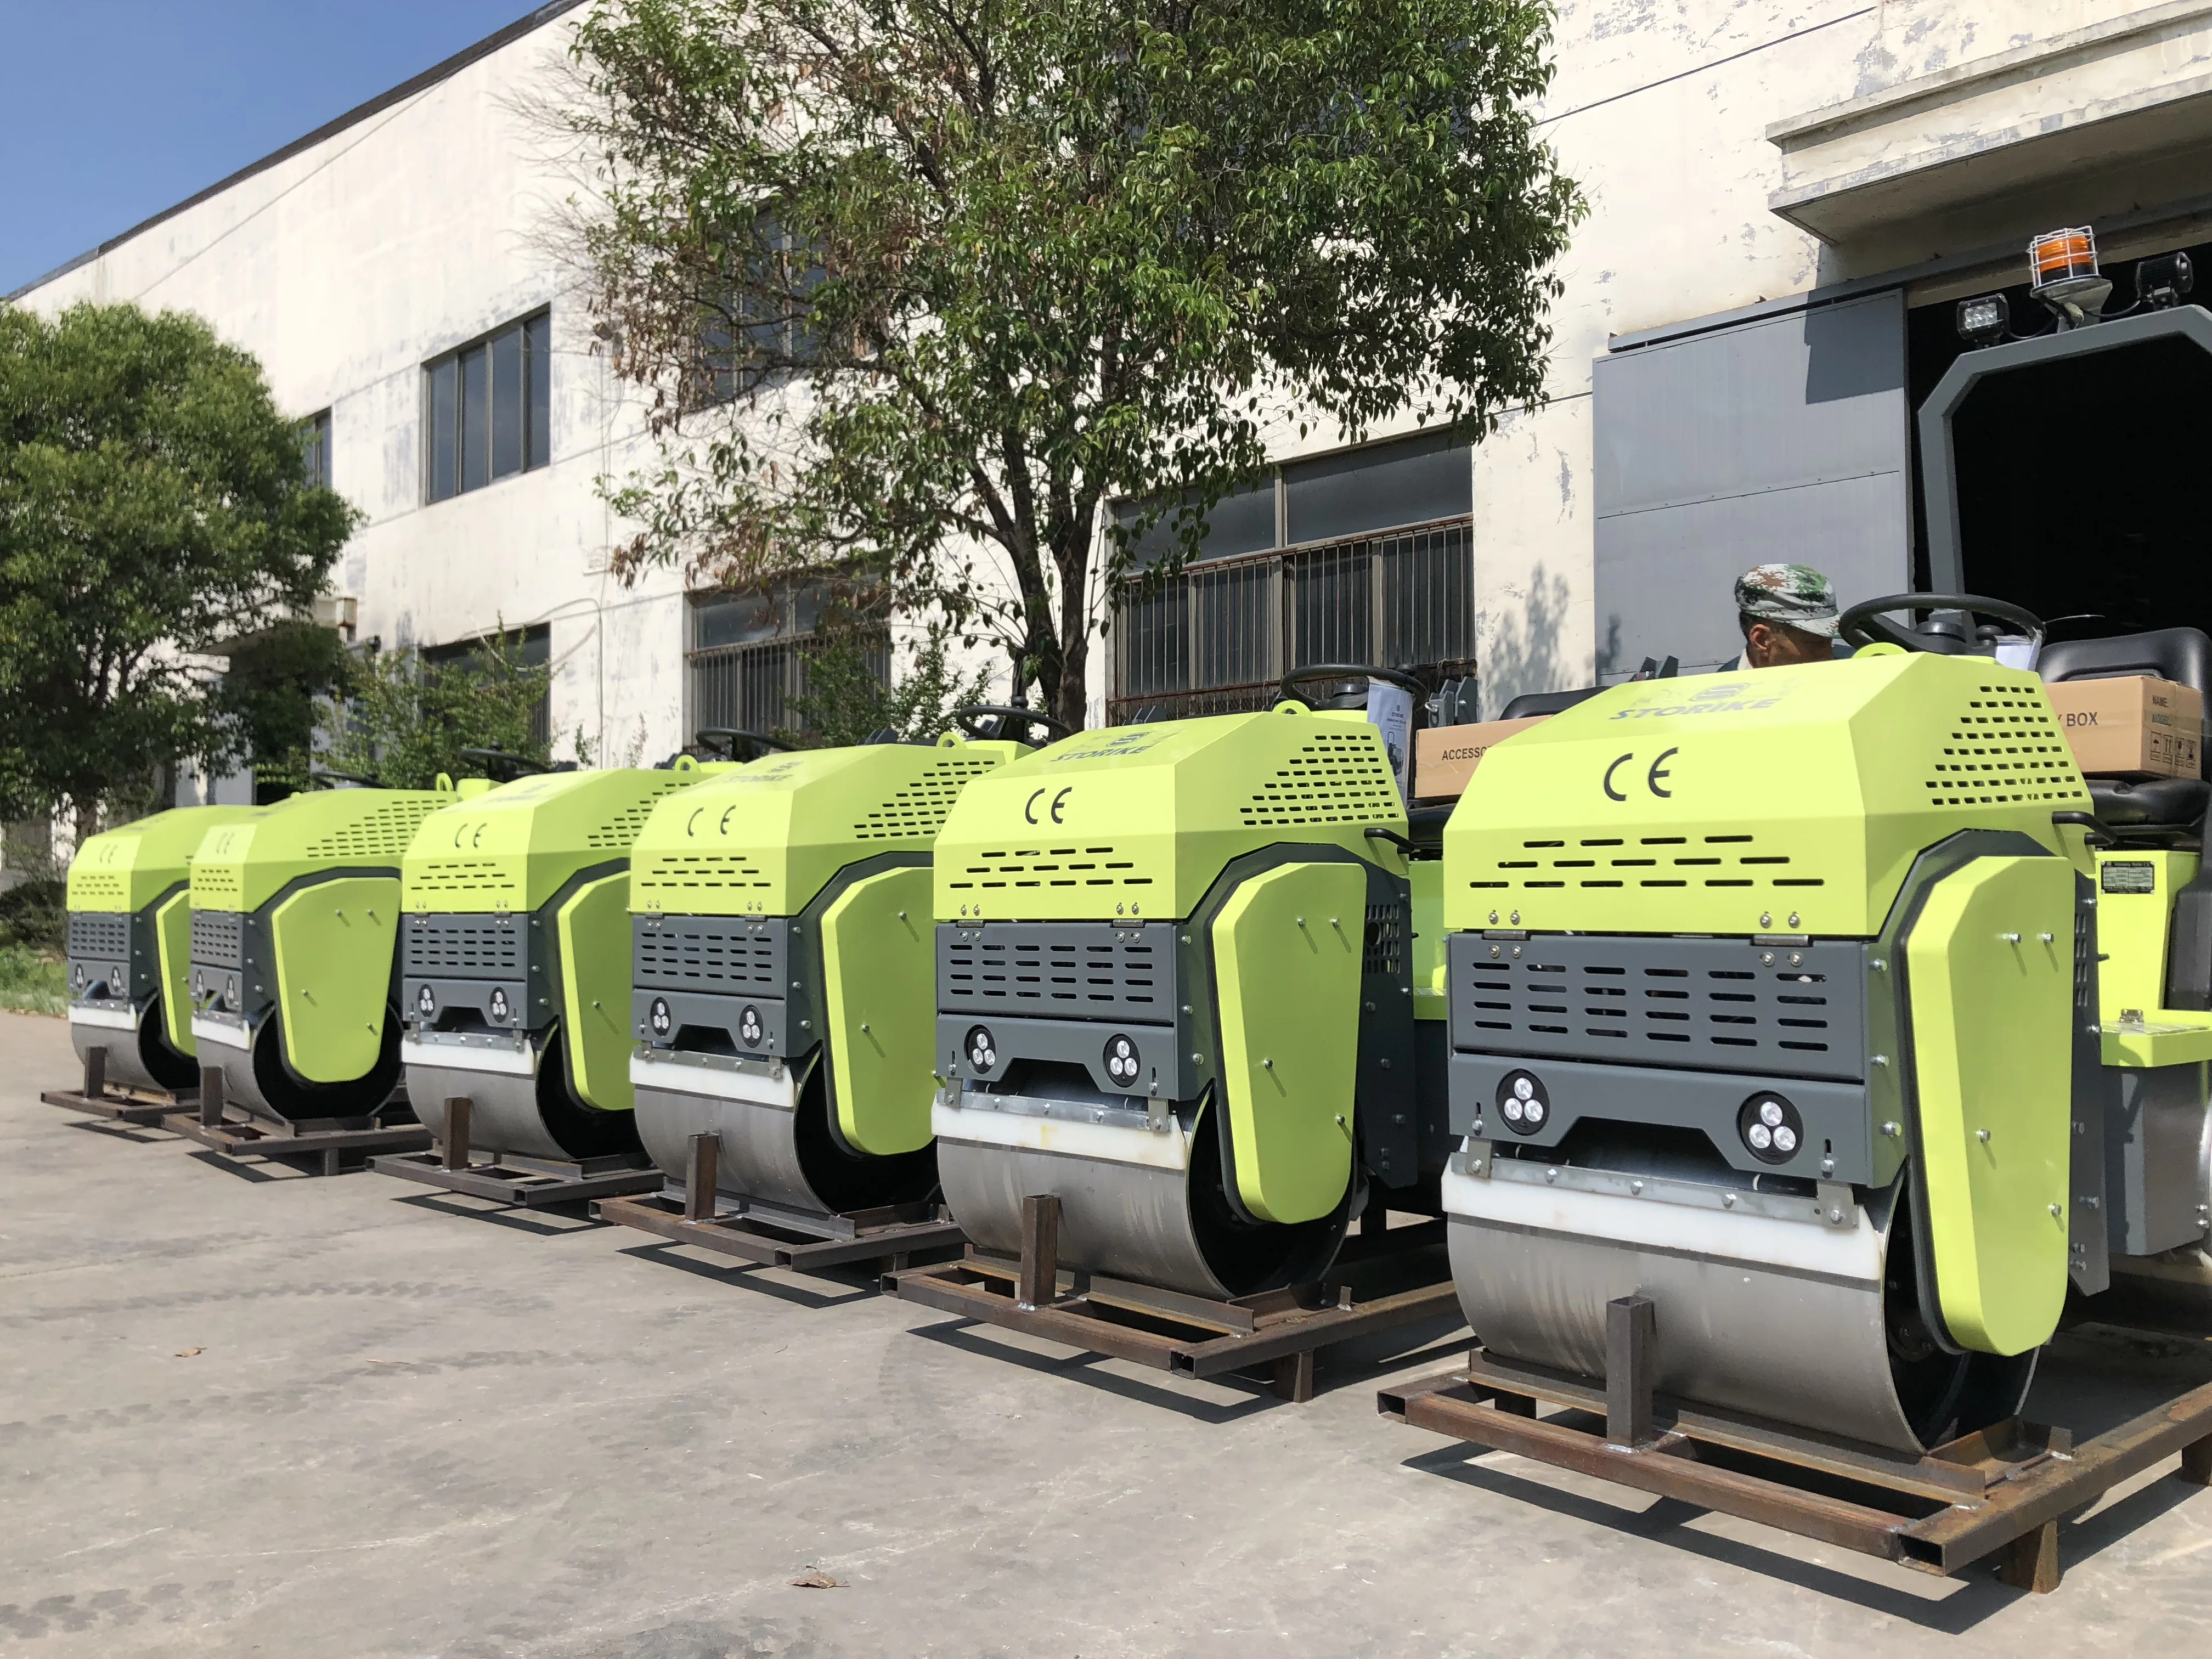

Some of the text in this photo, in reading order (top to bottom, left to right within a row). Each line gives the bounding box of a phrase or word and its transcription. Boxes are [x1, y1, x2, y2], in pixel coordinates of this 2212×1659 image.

[1609, 698, 1781, 720] STORIKE
[2067, 712, 2098, 726] BOX
[1049, 746, 1152, 762] STORIKE
[1442, 746, 1492, 761] ACCESSO
[1603, 747, 1679, 802] CE
[1025, 786, 1073, 825] CE
[687, 804, 736, 837] CE
